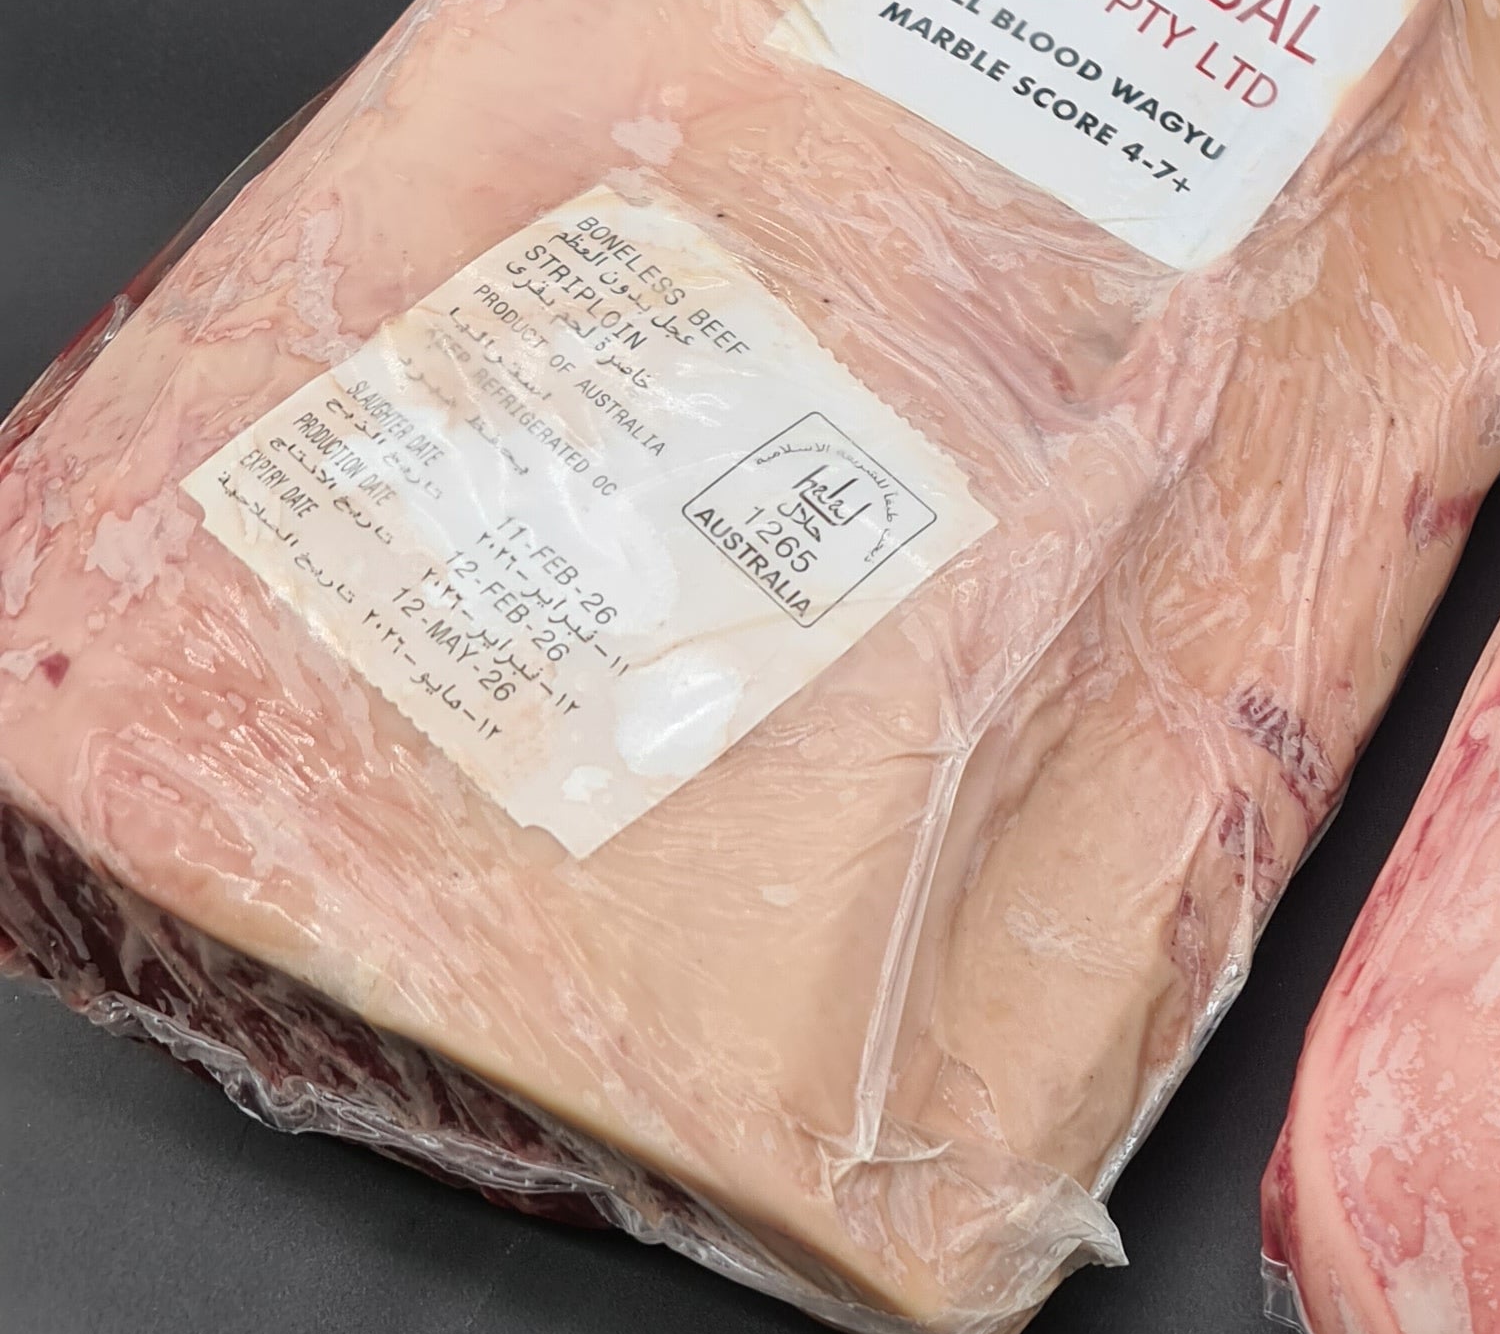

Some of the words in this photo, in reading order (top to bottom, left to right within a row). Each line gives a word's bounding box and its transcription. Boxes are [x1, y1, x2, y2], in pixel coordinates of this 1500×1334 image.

[878, 0, 1010, 82] MARBLE
[1012, 75, 1116, 147] SCORE
[1121, 142, 1192, 195] 4-7+
[990, 7, 1103, 82] BLOOD
[1110, 76, 1226, 161] WAGYU
[1194, 41, 1279, 110] LTD
[525, 245, 648, 352] STRIPLOIN
[548, 231, 609, 267] العظم
[576, 216, 687, 306] BONELESS
[688, 308, 751, 357] BEEF
[599, 270, 652, 315] بدون
[472, 284, 550, 350] PRODUCT
[549, 353, 578, 375] OF
[573, 378, 667, 457] AUSTRALIA
[650, 315, 695, 347] عجل
[472, 367, 591, 474] REFRIGERATED
[293, 411, 369, 480] PRODUCTION
[358, 473, 399, 508] DATE
[446, 549, 571, 663] 12-FEB-26
[346, 380, 408, 440] SLAUGHTER
[405, 434, 445, 467] DATE
[496, 516, 618, 625] 11-FEB-26
[744, 505, 819, 574] 1265
[776, 501, 822, 544] حلال
[791, 464, 873, 527] halal
[239, 448, 291, 491] EXPIRY
[279, 485, 319, 519] DATE
[392, 586, 517, 702] 12-MAY-26
[693, 507, 812, 619] AUSTRALIA
